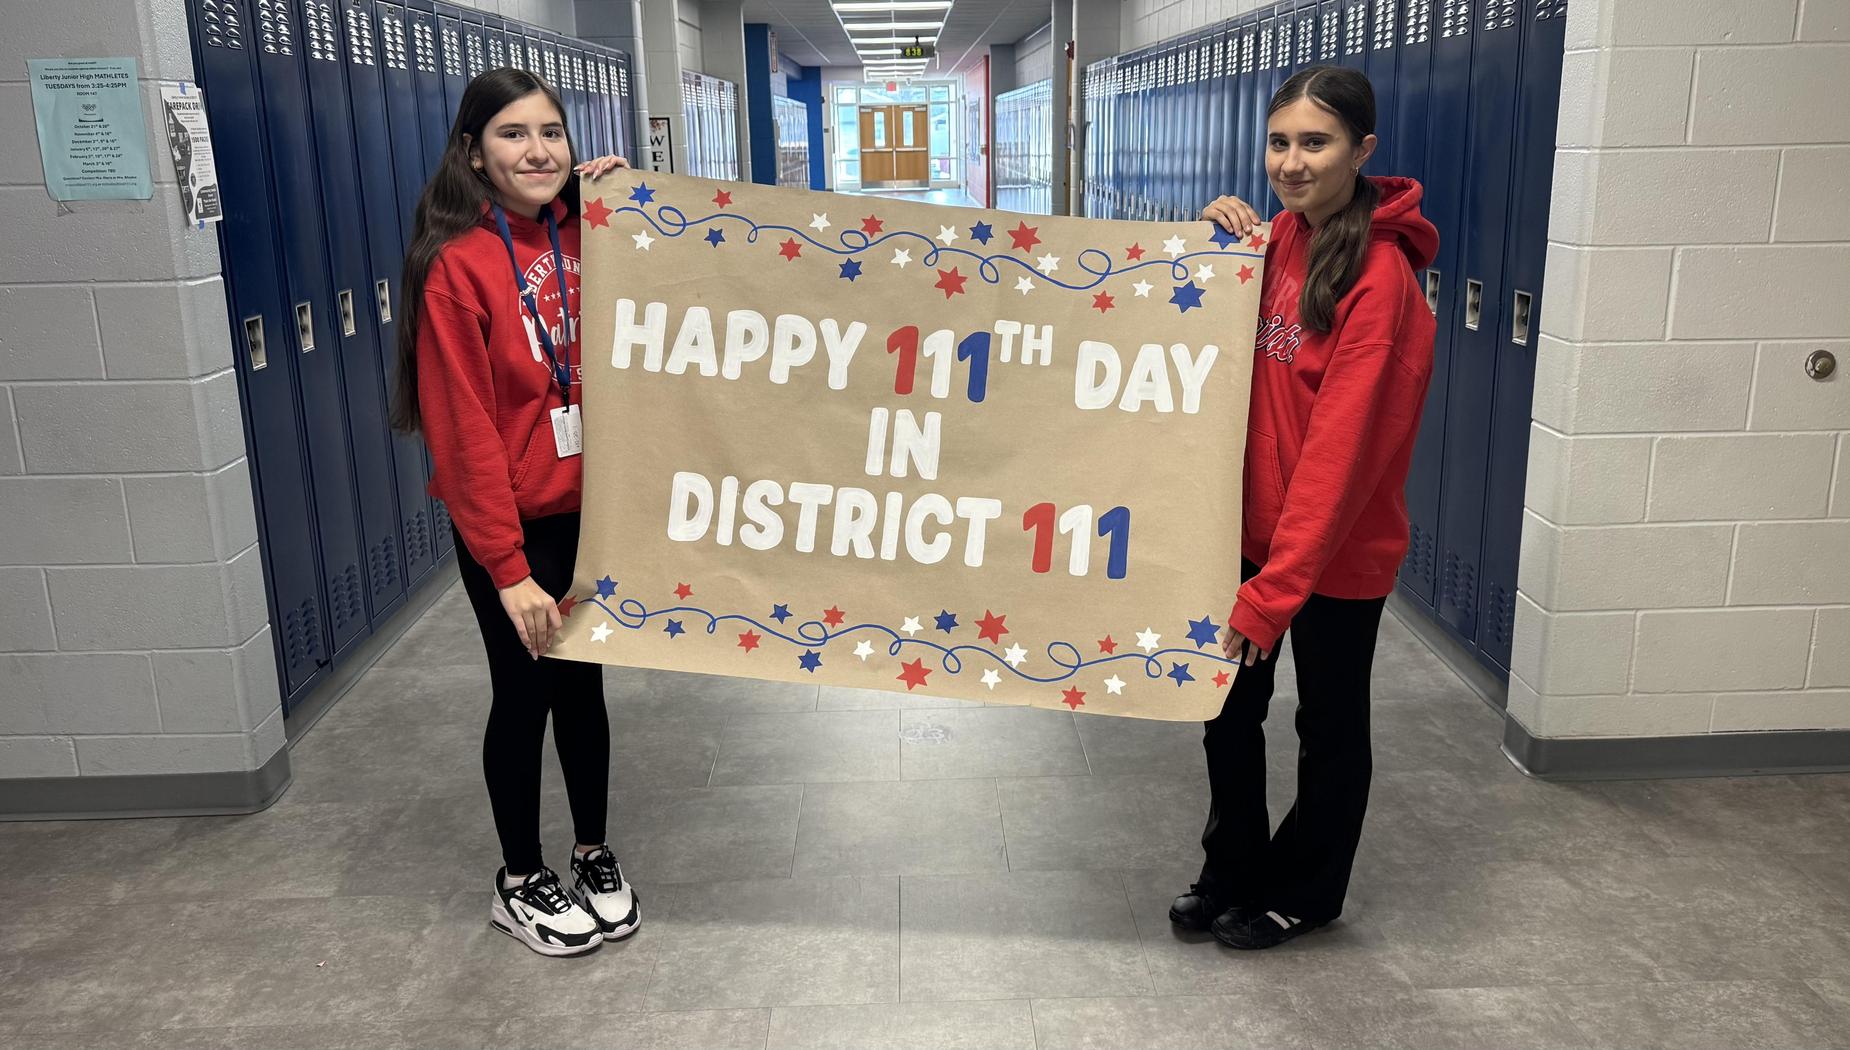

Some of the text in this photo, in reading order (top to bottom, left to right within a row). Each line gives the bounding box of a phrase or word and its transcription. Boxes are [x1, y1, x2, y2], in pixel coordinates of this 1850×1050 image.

[611, 298, 867, 390] HAPPY
[1074, 340, 1219, 414] DAY
[865, 407, 942, 480] IN
[667, 471, 1130, 579] DISTRICT 111
